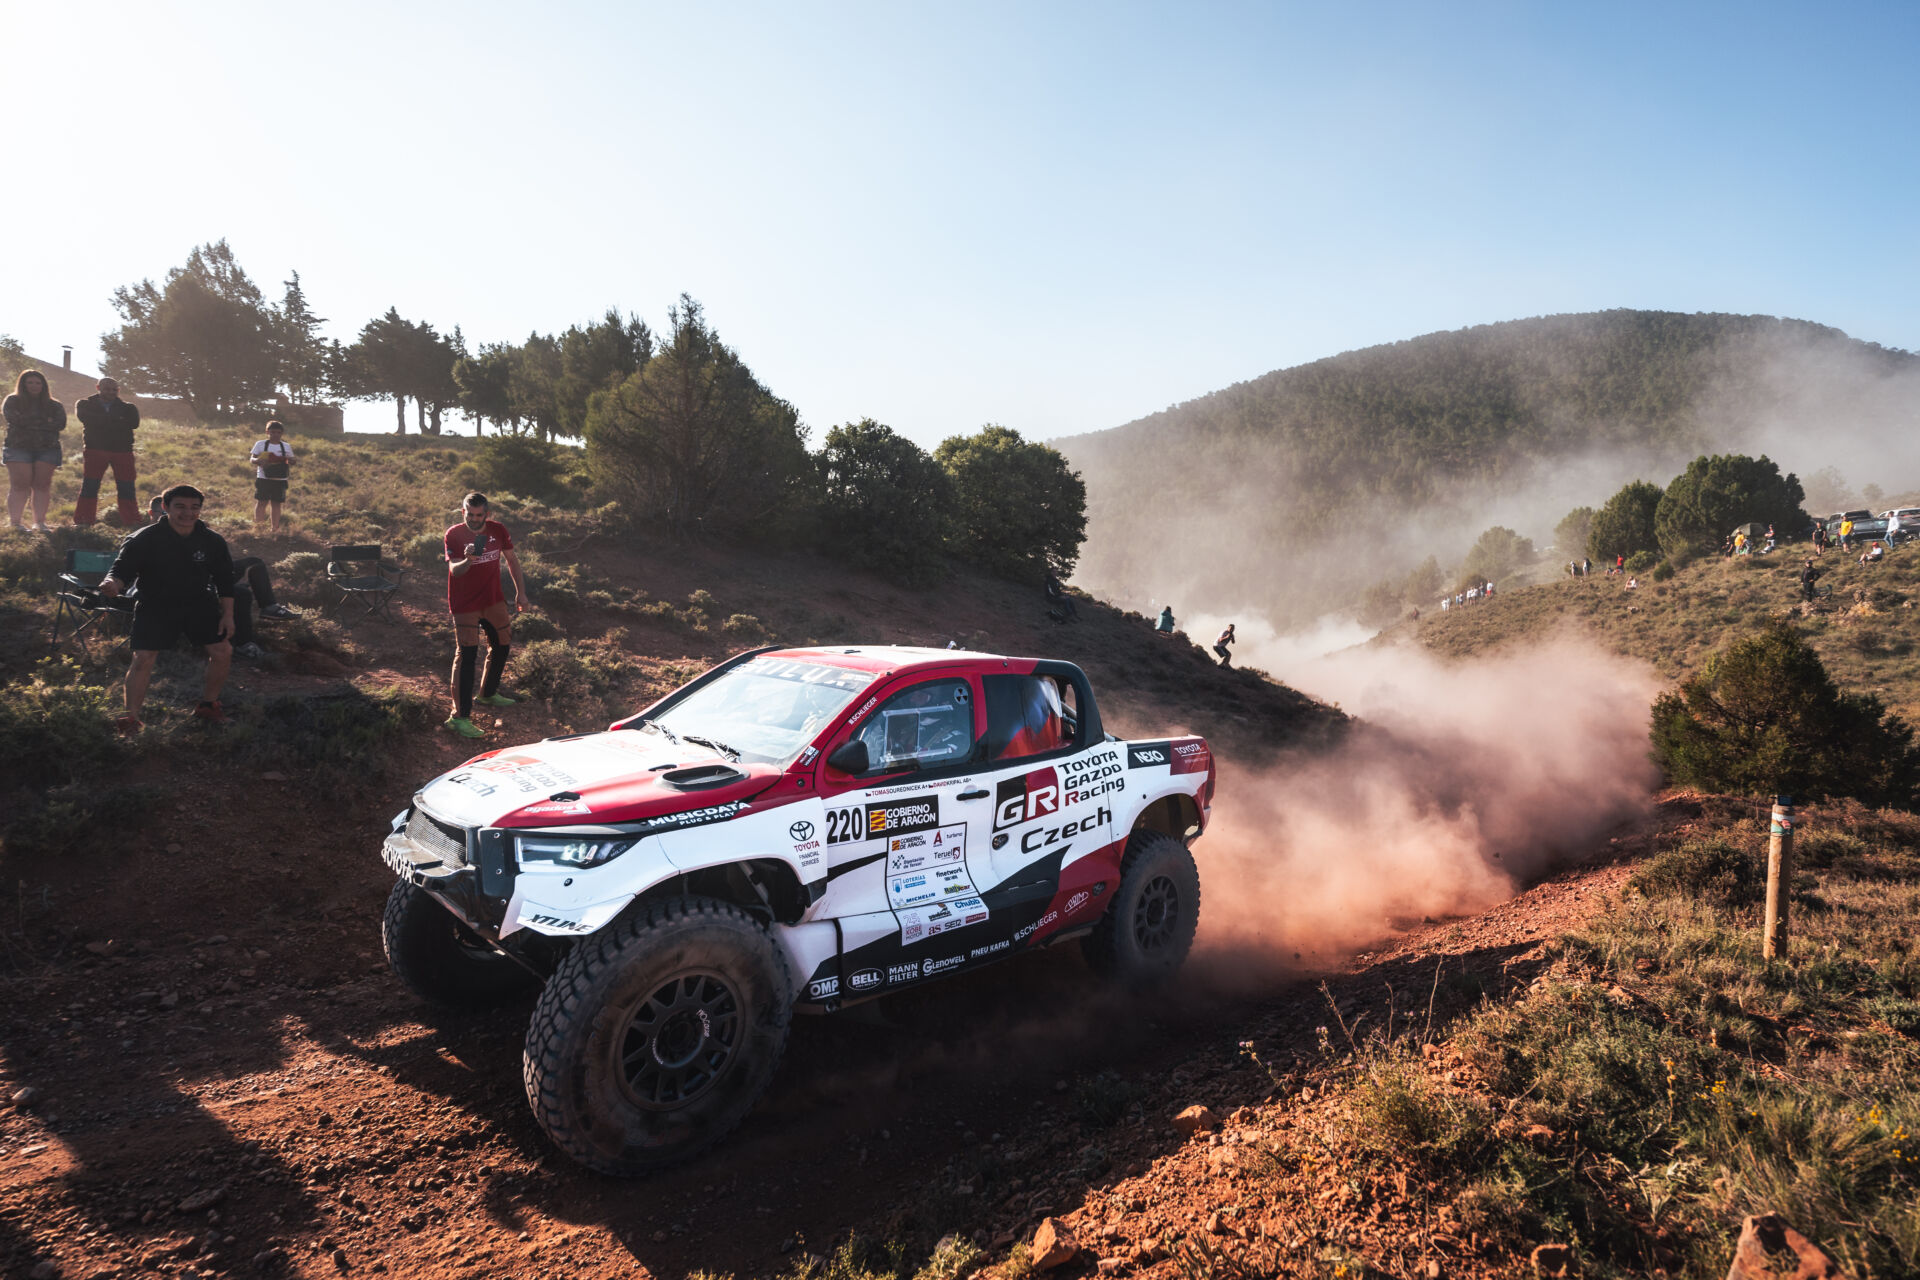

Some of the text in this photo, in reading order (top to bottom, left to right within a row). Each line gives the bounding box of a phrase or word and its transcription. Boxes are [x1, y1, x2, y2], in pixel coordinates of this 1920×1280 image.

[852, 697, 877, 723] SCHLIEGER
[1134, 750, 1165, 763] NEXO
[1174, 744, 1202, 755] TOYOTA
[1058, 750, 1119, 775] TOYOTA
[1064, 763, 1122, 790] GAZOO
[1064, 777, 1125, 806] Racing
[647, 802, 752, 827] MUSICDATA
[886, 803, 930, 819] GOBIERNO
[996, 785, 1058, 828] GR
[679, 817, 703, 826] PLUG
[714, 810, 735, 820] PLAY
[826, 807, 863, 844] 220
[886, 819, 898, 830] DE
[1020, 806, 1112, 854] Czech
[794, 840, 820, 853] TOYOTA
[933, 848, 953, 860] Teruel
[798, 851, 819, 861] FINANCIAL
[801, 858, 819, 867] SERVICES
[906, 892, 936, 903] MICHELIN
[955, 898, 980, 909] Chubb
[527, 914, 595, 932] XTLINE
[928, 924, 942, 935] as
[1019, 910, 1058, 939] SCHLIEGER
[970, 939, 1010, 958] PNEU KAFKA
[889, 963, 918, 975] MANN
[889, 970, 918, 983] FILTER
[852, 972, 880, 986] BELL
[810, 980, 839, 996] OMP
